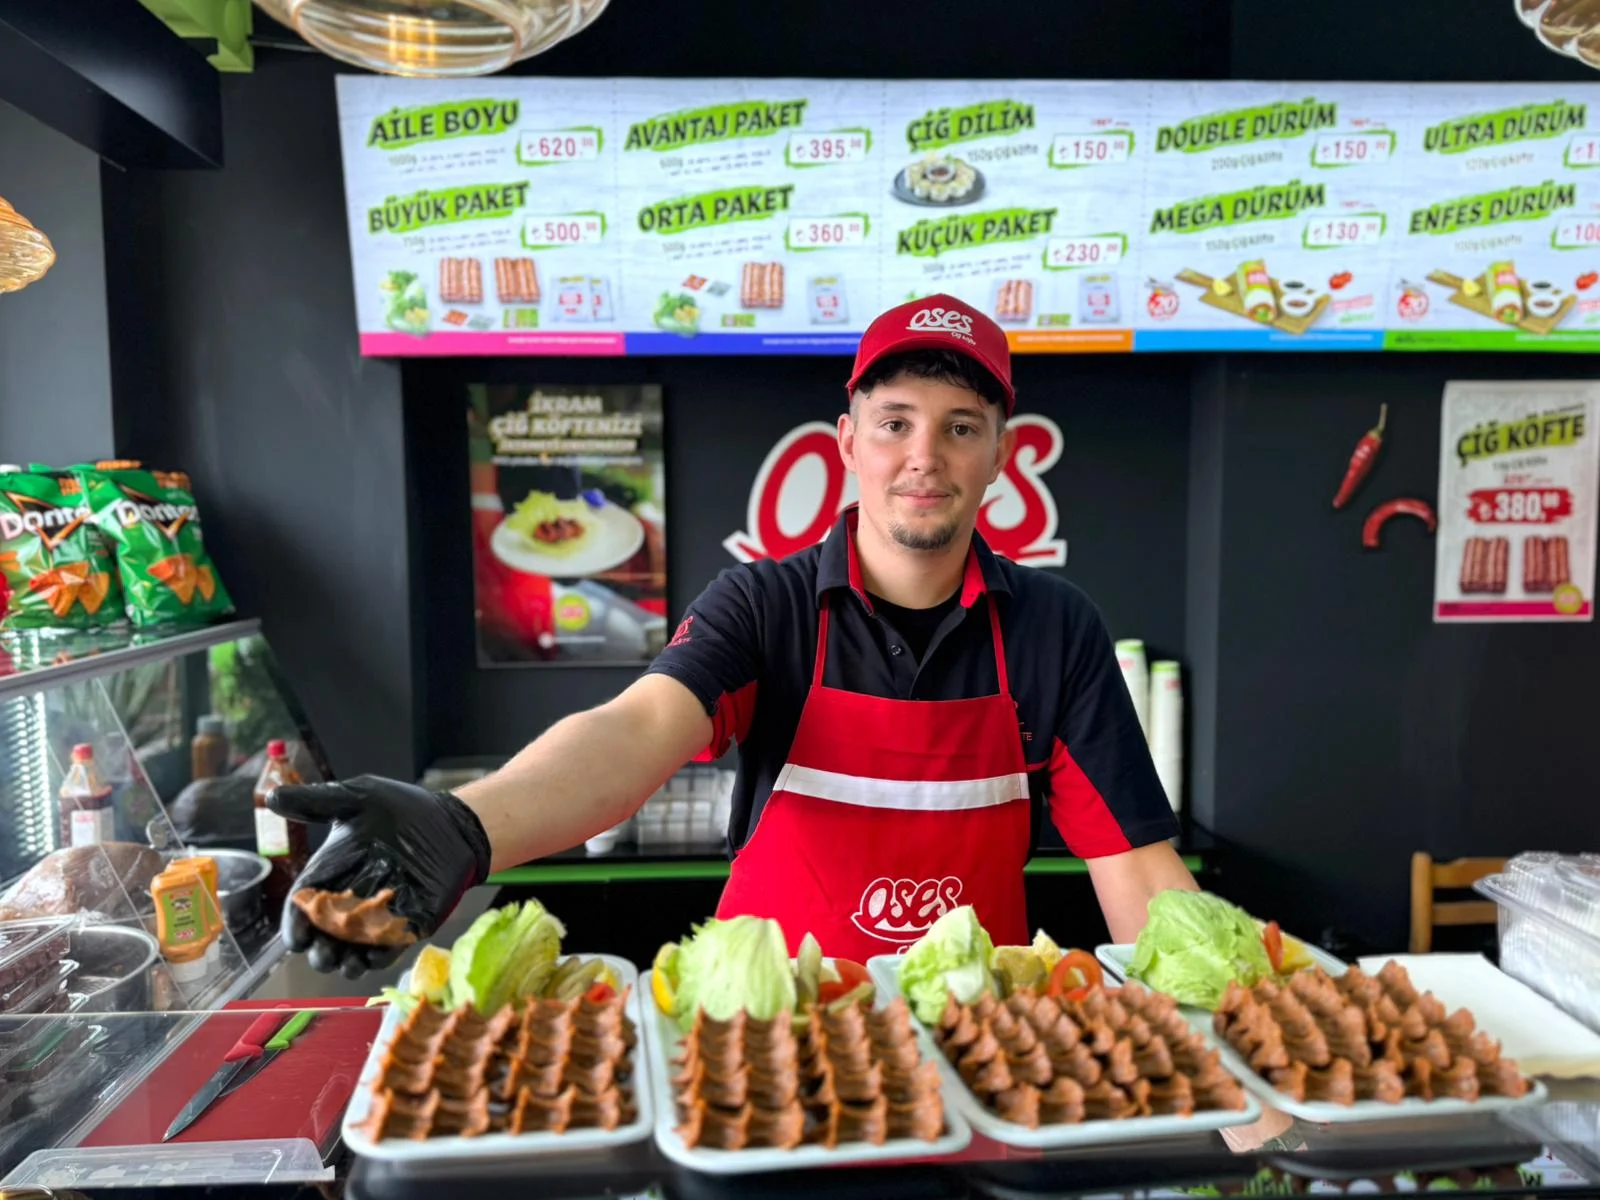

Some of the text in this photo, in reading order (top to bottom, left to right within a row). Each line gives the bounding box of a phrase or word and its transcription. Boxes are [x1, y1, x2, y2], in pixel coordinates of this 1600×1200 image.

[369, 102, 519, 145] AİLE BOYU
[625, 101, 808, 151] AVANTAJ PAKET
[906, 100, 1035, 151] ÇİĞ DİLİM
[1156, 98, 1338, 152] DOUBLE DÜRÜM
[1423, 99, 1586, 152] ULTRA DÜRÜM
[369, 181, 530, 234] BÜYÜK PAKET
[638, 184, 795, 232] ORTA PAKET
[897, 208, 1058, 257] KÜÇÜK PAKET
[1149, 179, 1326, 234] MEGA DÜRÜM
[1408, 179, 1576, 235] ENFES DÜRÜM
[1456, 413, 1585, 468] ÇİĞ KÖFTE
